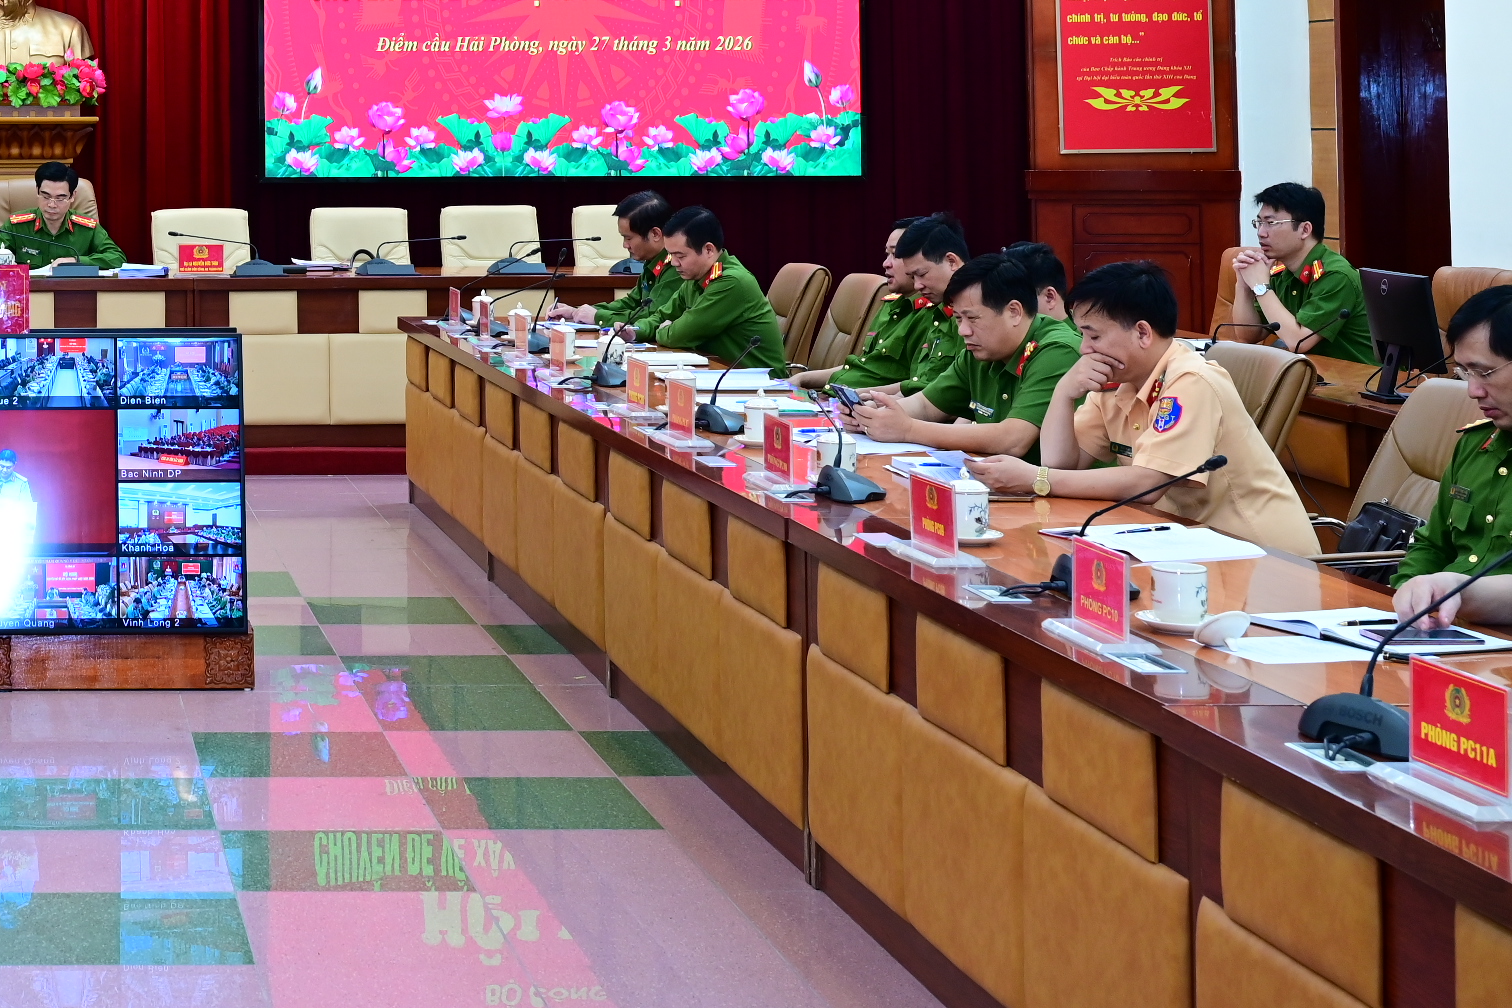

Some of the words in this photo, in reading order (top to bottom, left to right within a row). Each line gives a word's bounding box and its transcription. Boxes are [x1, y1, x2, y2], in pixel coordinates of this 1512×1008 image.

[375, 32, 419, 52] Điểm
[422, 33, 451, 52] cầu
[455, 36, 485, 52] Hải
[488, 36, 543, 55] Phòng,
[548, 36, 586, 55] ngày
[589, 36, 609, 51] 27
[613, 35, 659, 55] tháng
[663, 36, 672, 51] 3
[676, 37, 711, 51] năm
[715, 36, 753, 51] 2026
[1068, 36, 1088, 44] chức
[1091, 35, 1100, 44] và
[1104, 35, 1119, 44] cán
[13, 396, 18, 405] 2
[120, 396, 142, 405] Dien
[144, 396, 166, 405] Bien
[121, 469, 139, 478] Bac
[142, 469, 164, 478] Ninh
[167, 469, 182, 478] DP
[121, 543, 153, 553] Khanh
[155, 543, 174, 553] Hoa
[1080, 594, 1103, 615] PHÒNG
[1102, 604, 1119, 623] PC10
[23, 618, 55, 630] Quang
[122, 618, 145, 627] Vinh
[147, 618, 172, 629] Long
[174, 618, 180, 627] 2
[1340, 706, 1384, 727] BOSCH
[1420, 721, 1458, 752] PHÒNG
[1459, 736, 1497, 768] PC11A
